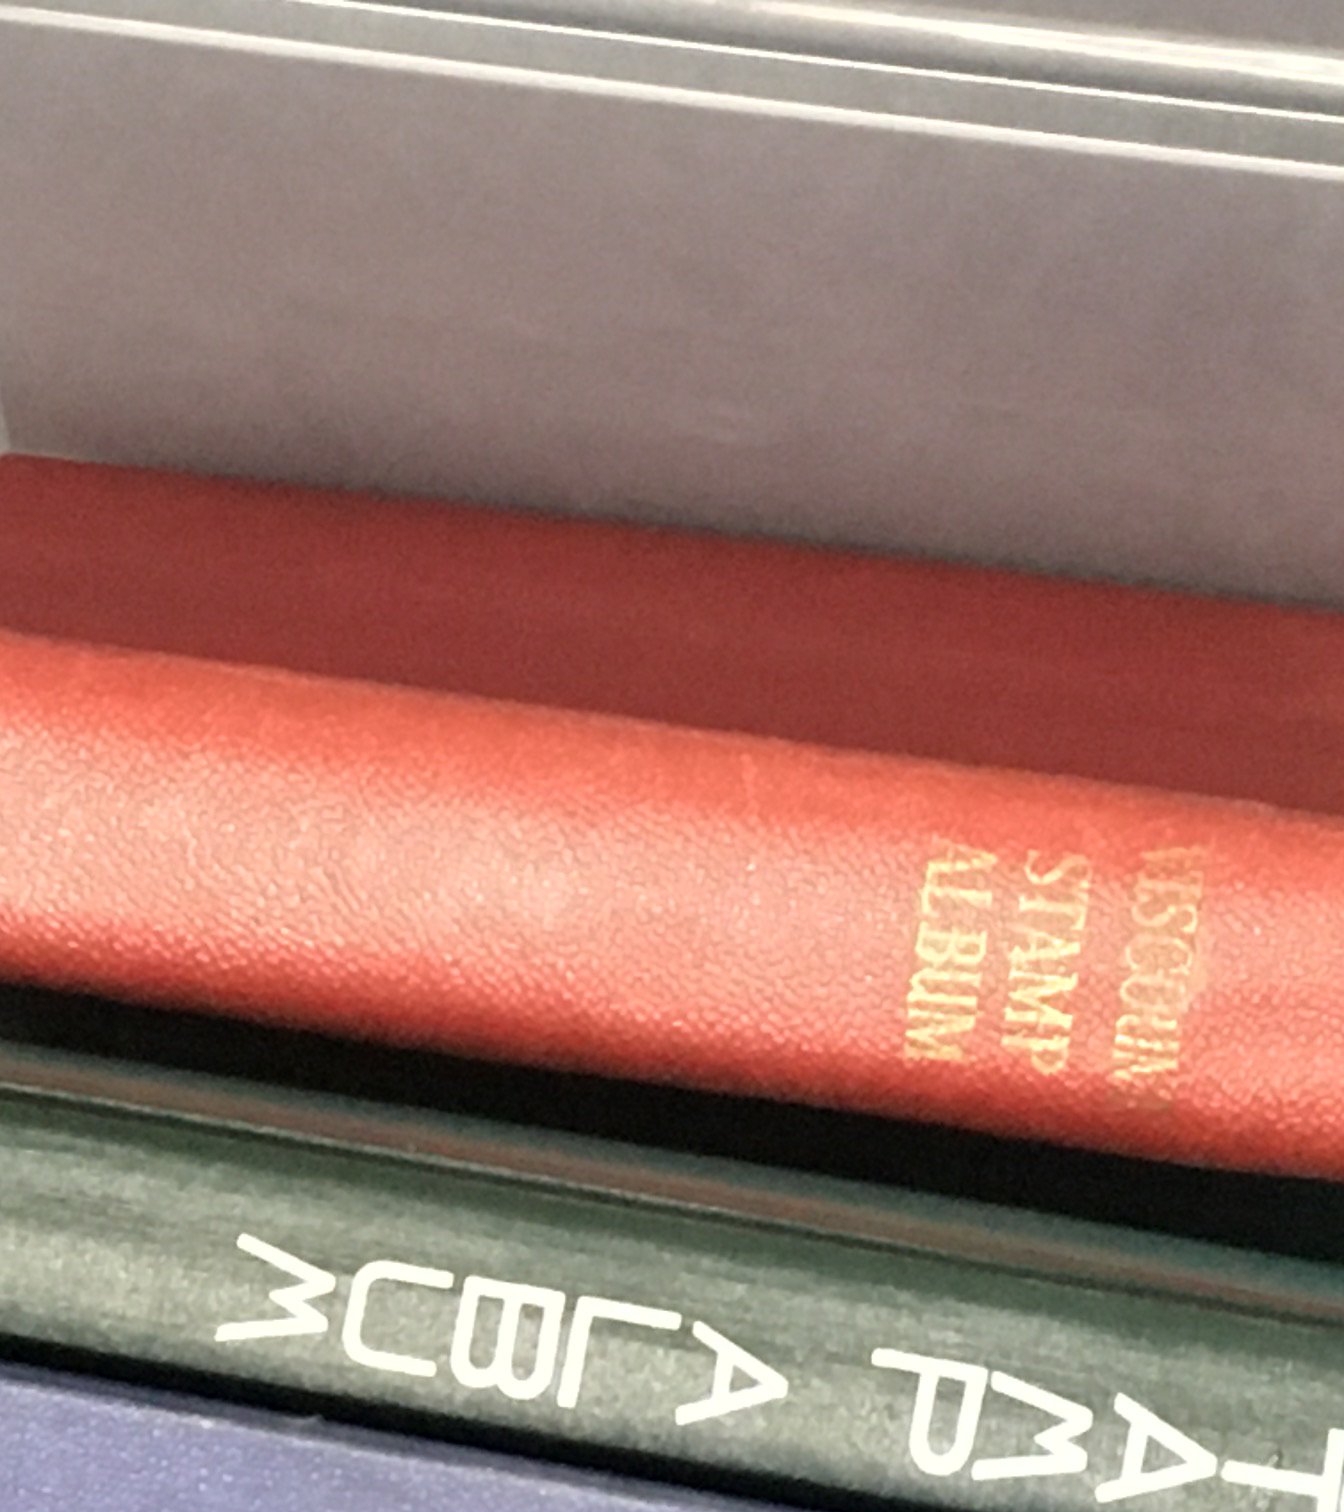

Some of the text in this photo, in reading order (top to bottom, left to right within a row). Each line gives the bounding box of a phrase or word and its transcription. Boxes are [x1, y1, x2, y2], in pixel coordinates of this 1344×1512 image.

[903, 834, 998, 1062] ALBUM
[1001, 848, 1093, 1076] STAMP
[215, 1232, 789, 1424] ALBUM
